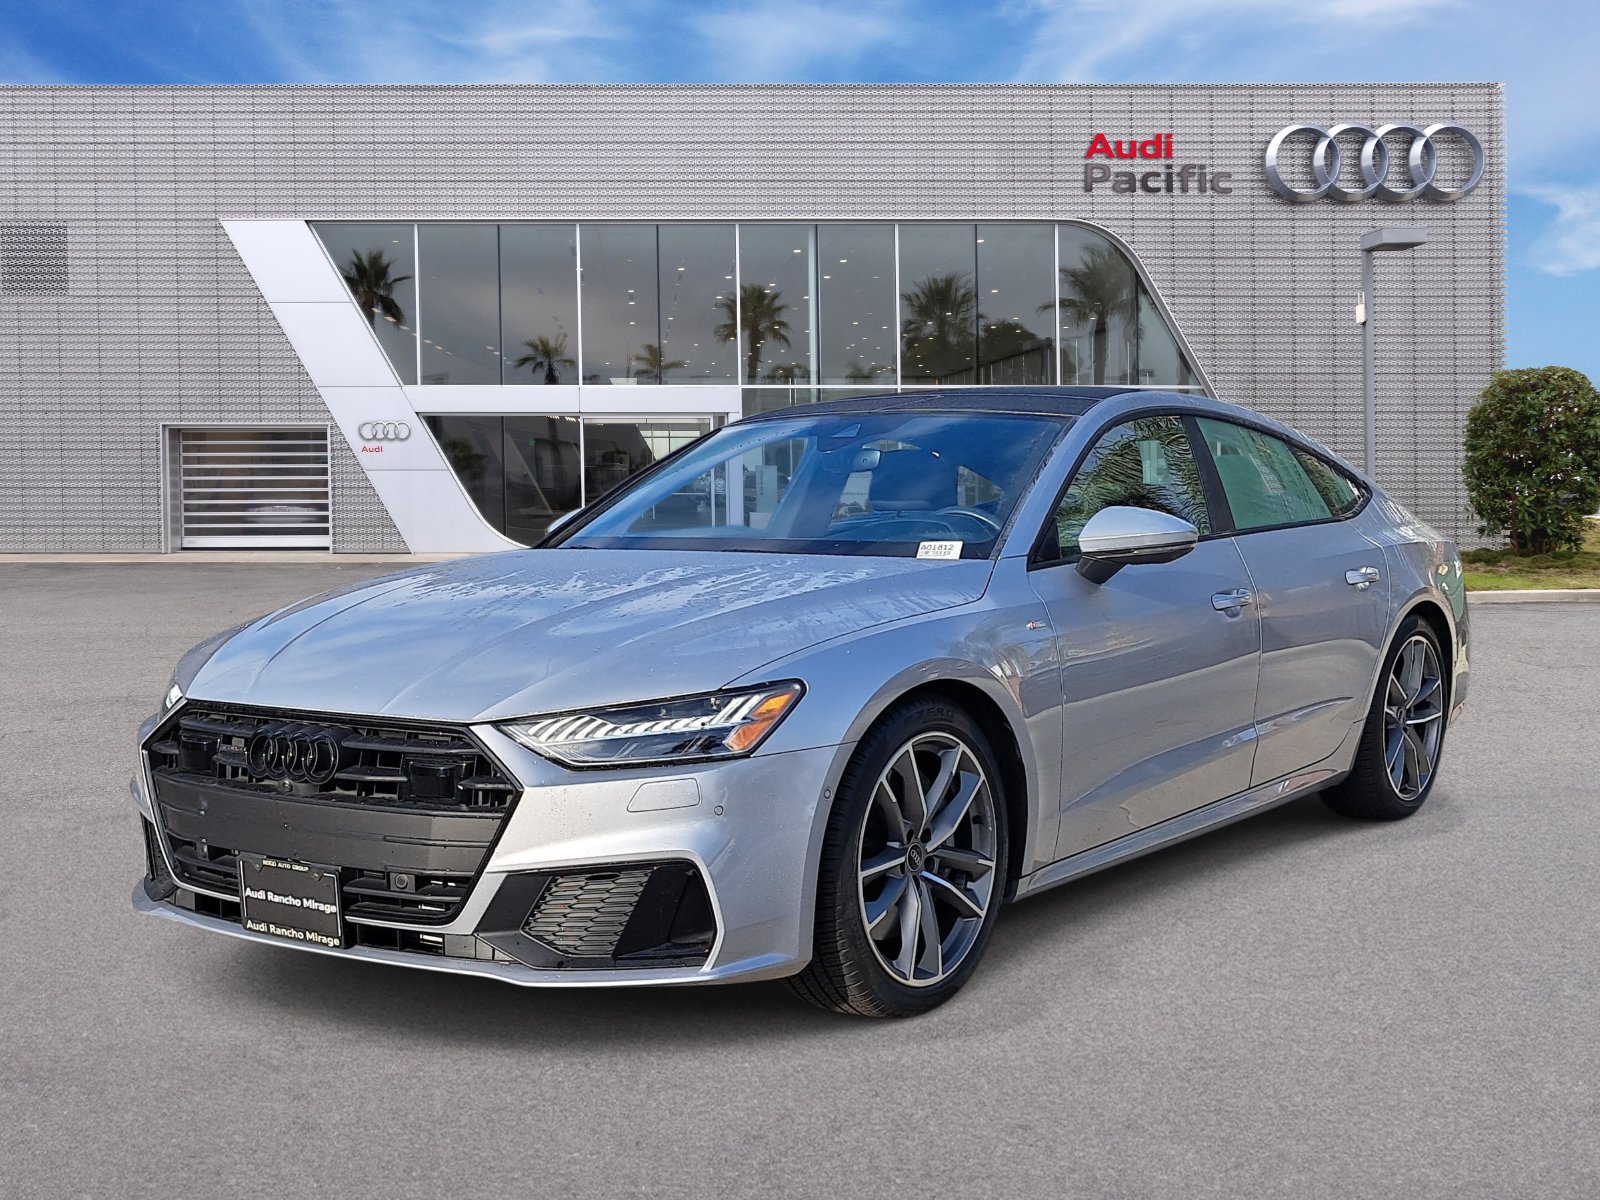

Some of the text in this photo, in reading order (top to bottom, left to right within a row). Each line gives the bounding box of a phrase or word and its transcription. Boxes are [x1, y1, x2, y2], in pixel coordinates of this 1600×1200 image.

[1084, 133, 1173, 159] Audi
[1084, 163, 1233, 194] Pacific
[361, 445, 383, 453] Audi
[245, 887, 337, 914] Audi Rancho Mirage
[246, 919, 340, 947] Audi Rancho Mirage
